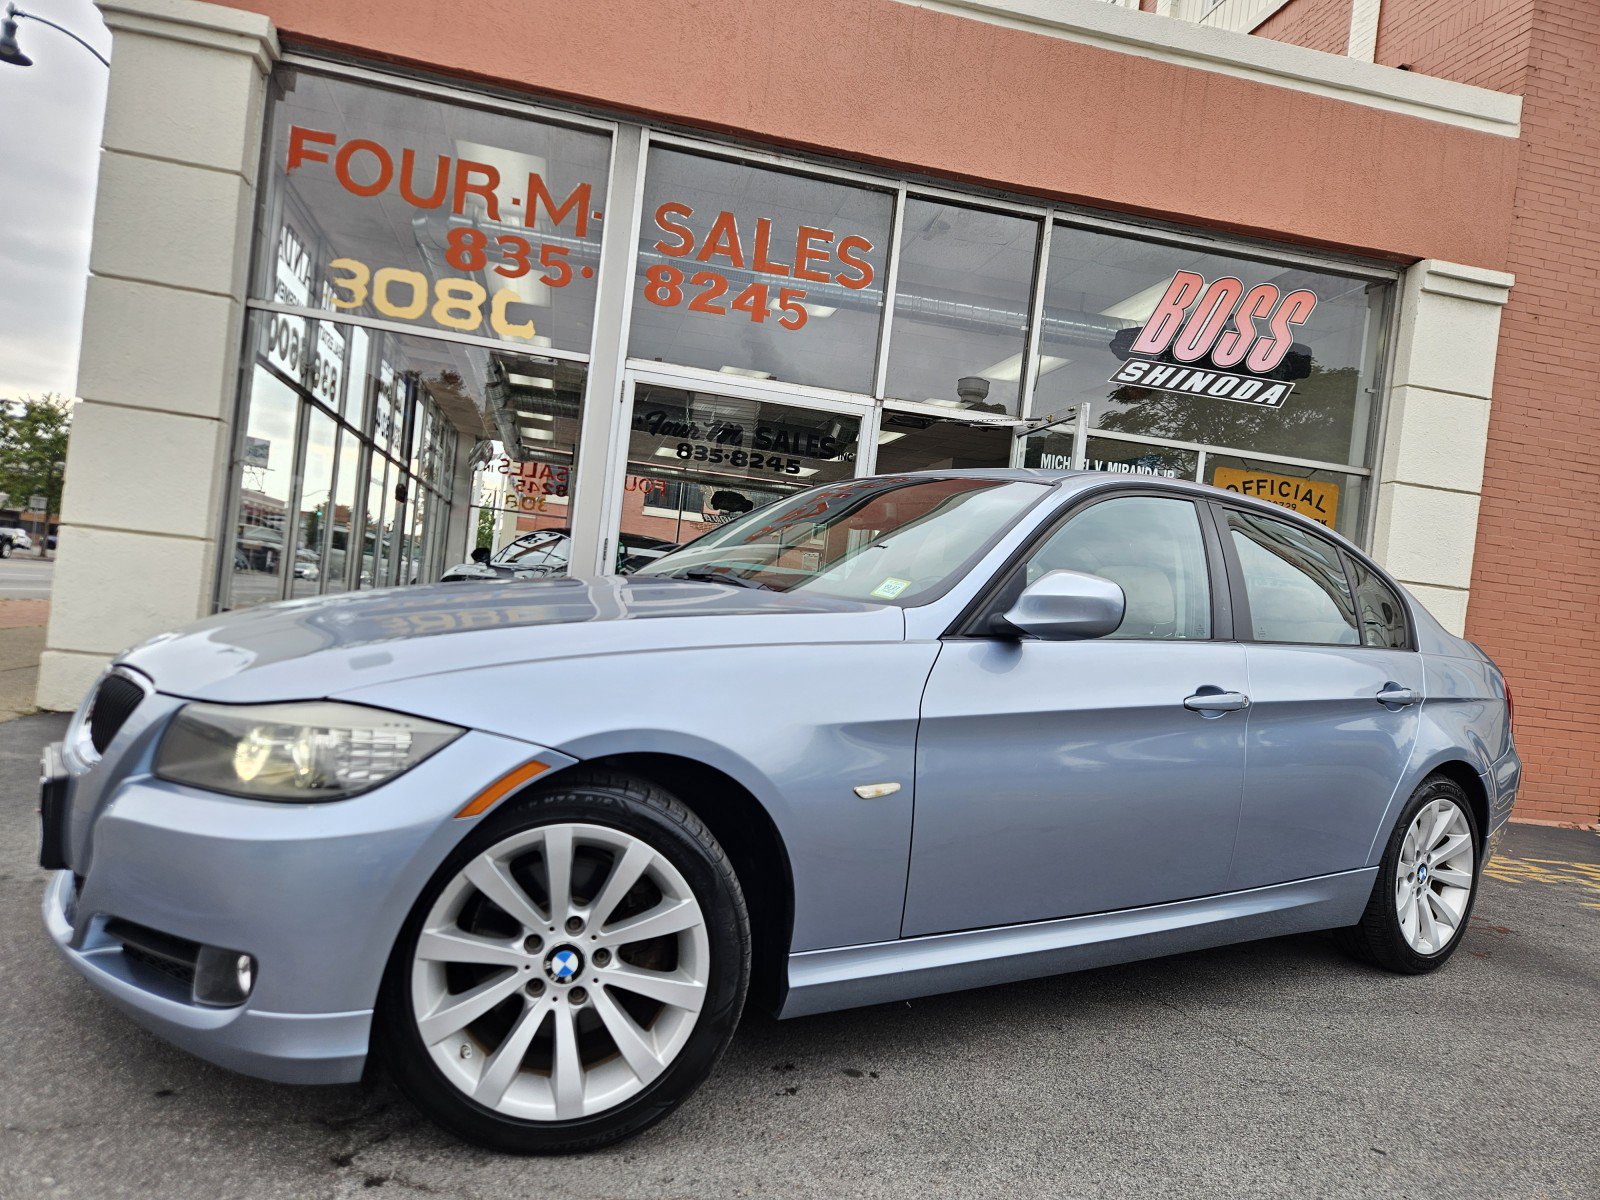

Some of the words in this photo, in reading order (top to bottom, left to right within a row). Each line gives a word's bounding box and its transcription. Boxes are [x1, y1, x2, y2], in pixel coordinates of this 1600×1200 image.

[653, 201, 876, 290] SALES
[643, 264, 808, 331] 8245
[1129, 269, 1318, 373] BOSS
[1117, 361, 1292, 406] SHINODA
[754, 426, 837, 458] SALES
[1040, 453, 1090, 470] MICHL
[1107, 462, 1159, 477] MIRANDA
